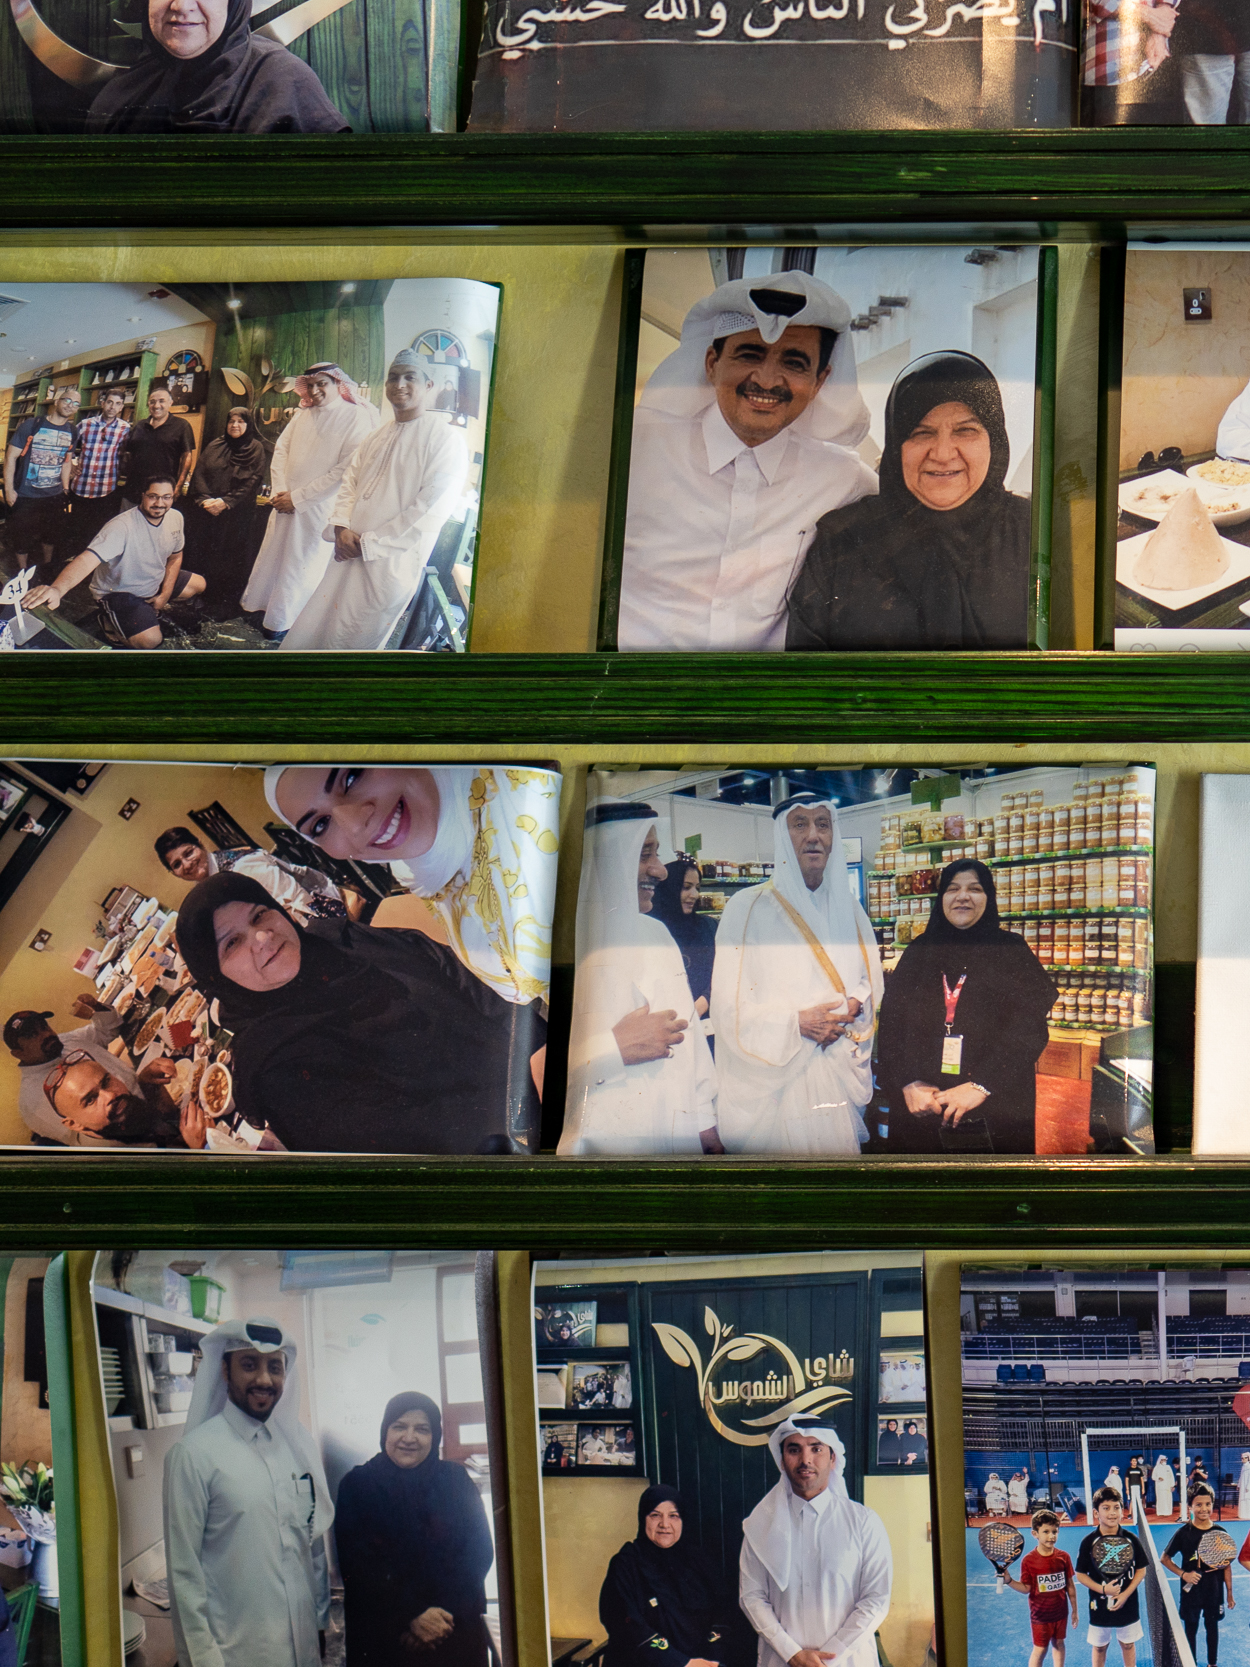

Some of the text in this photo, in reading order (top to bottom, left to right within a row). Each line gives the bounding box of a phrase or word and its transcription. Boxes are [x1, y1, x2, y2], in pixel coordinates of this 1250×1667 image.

[8, 580, 22, 600] 34
[805, 1349, 855, 1387] شاي
[708, 1370, 796, 1406] الشموس
